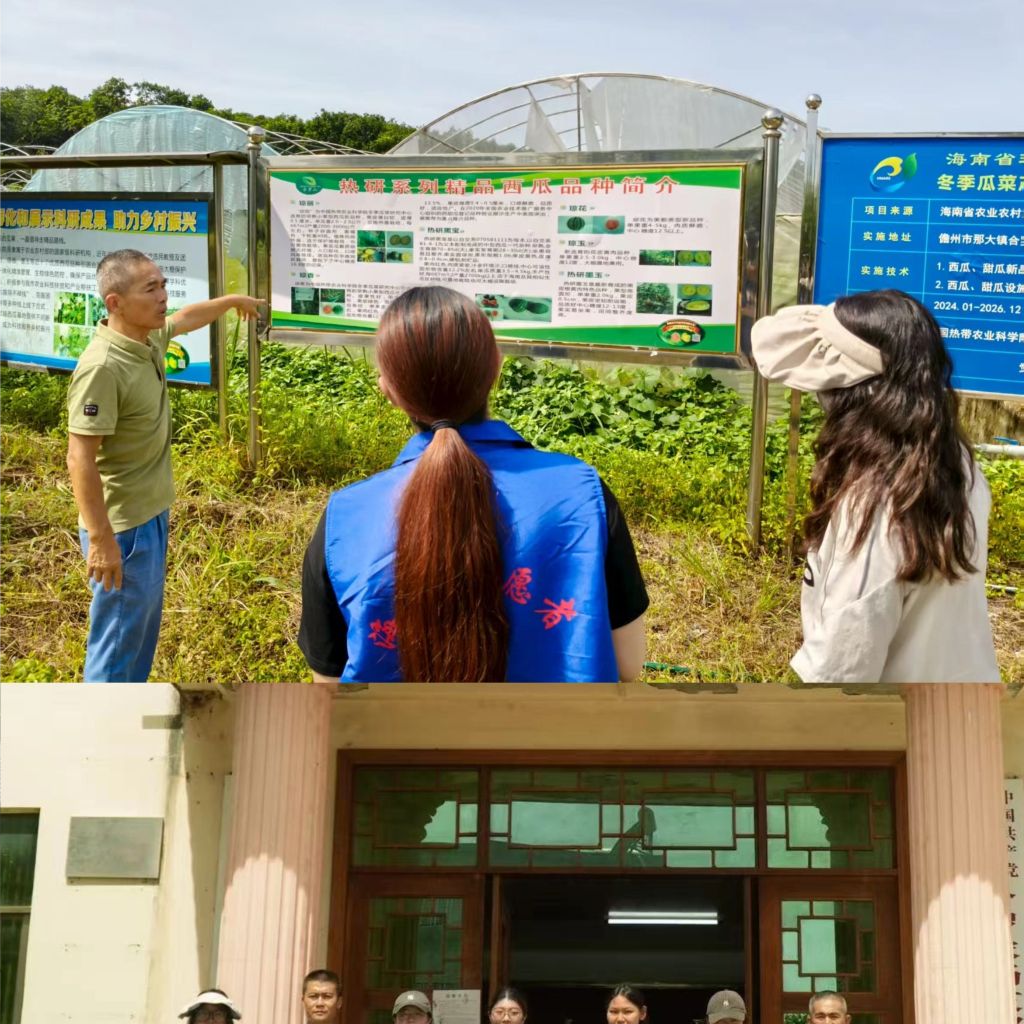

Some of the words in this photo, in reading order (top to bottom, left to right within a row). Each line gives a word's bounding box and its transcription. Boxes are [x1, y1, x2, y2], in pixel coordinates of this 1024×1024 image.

[339, 175, 680, 196] 热研系列精品西瓜品种简介
[864, 205, 914, 216] 项目来源
[940, 206, 1024, 219] 海南省农业农村
[113, 211, 197, 233] 助力乡村振兴
[863, 231, 913, 242] 实施地址
[860, 265, 910, 277] 实施技术
